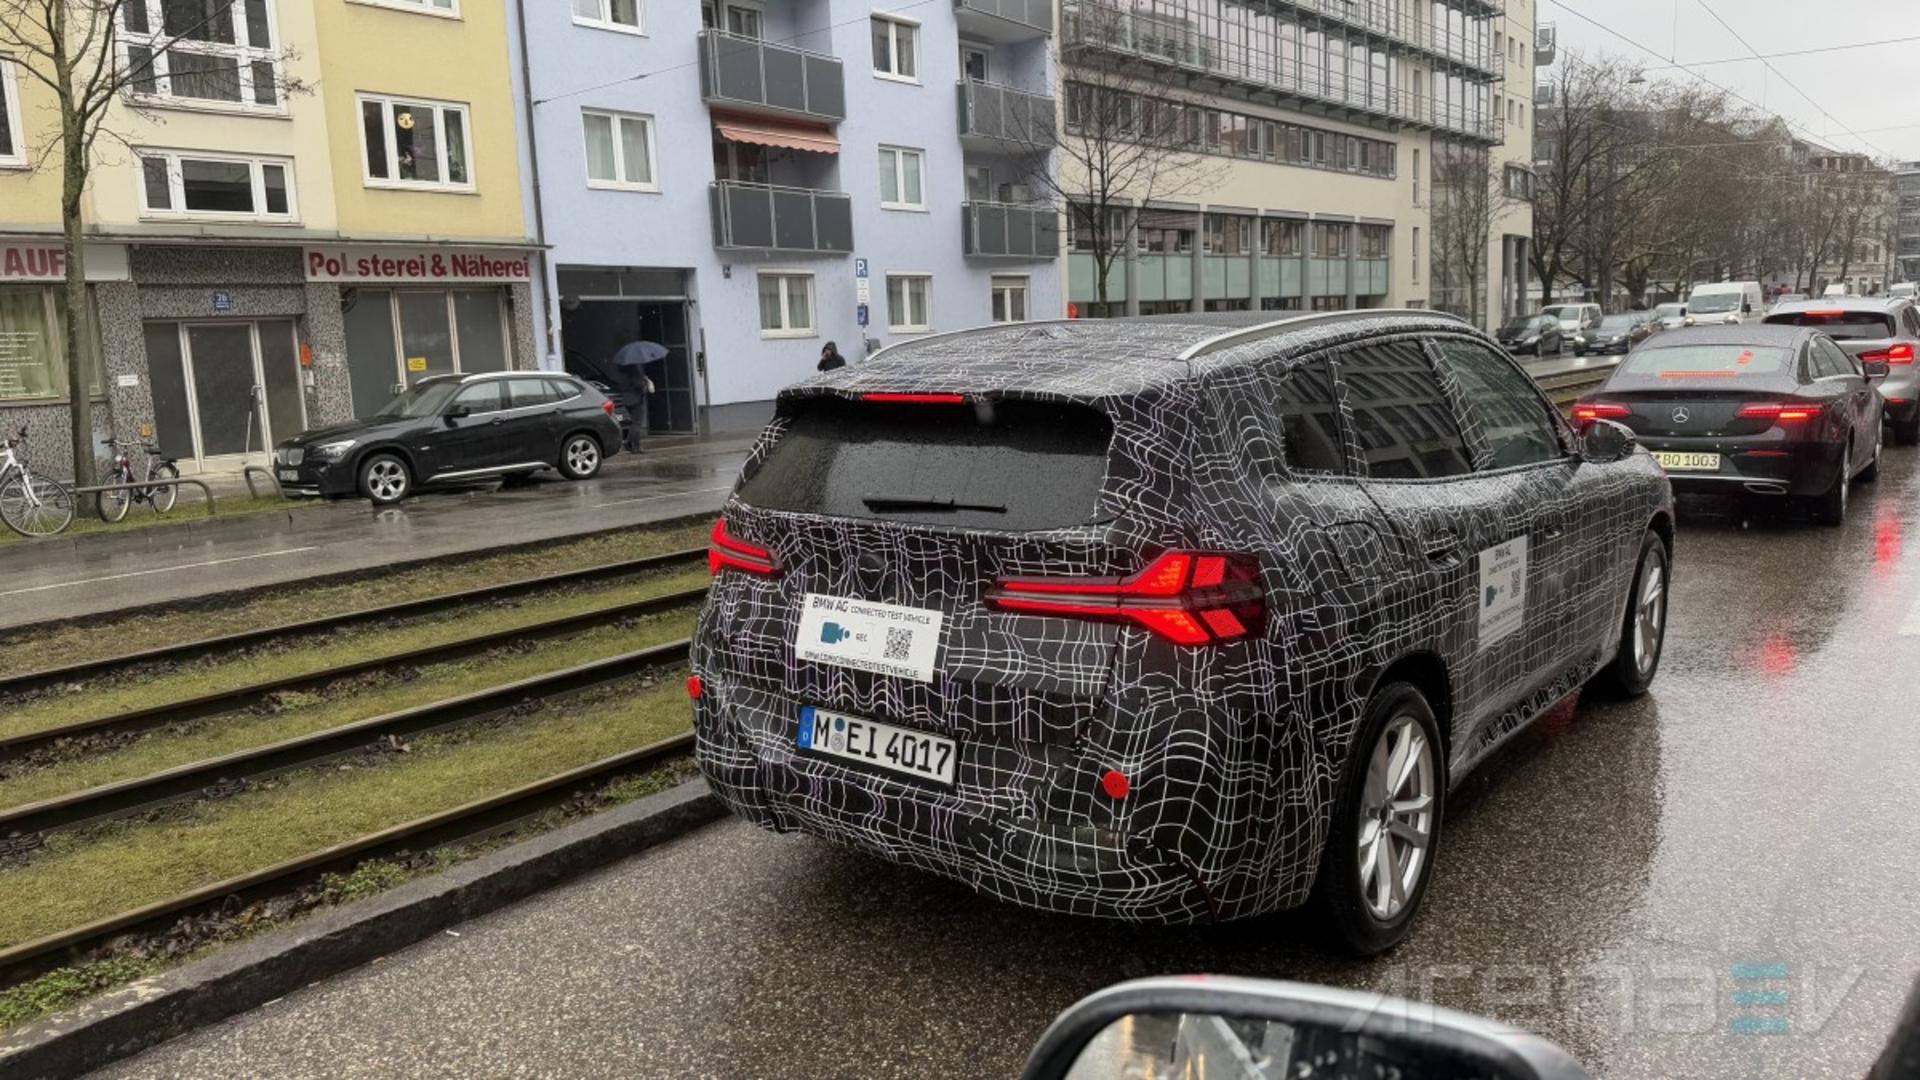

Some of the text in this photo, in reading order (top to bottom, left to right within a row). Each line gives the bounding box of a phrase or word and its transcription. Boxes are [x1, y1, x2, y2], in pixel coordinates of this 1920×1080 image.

[0, 247, 64, 277] AUF
[430, 253, 447, 276] &
[452, 254, 529, 278] Näherei
[857, 260, 865, 276] P
[1683, 454, 1718, 468] 1003
[812, 596, 835, 611] BMW
[835, 600, 849, 613] AG
[850, 605, 887, 618] CONNECTED
[887, 611, 903, 622] TEST
[855, 632, 868, 643] REC
[813, 714, 831, 748] M
[846, 722, 878, 760] EI
[885, 732, 953, 776] 4017
